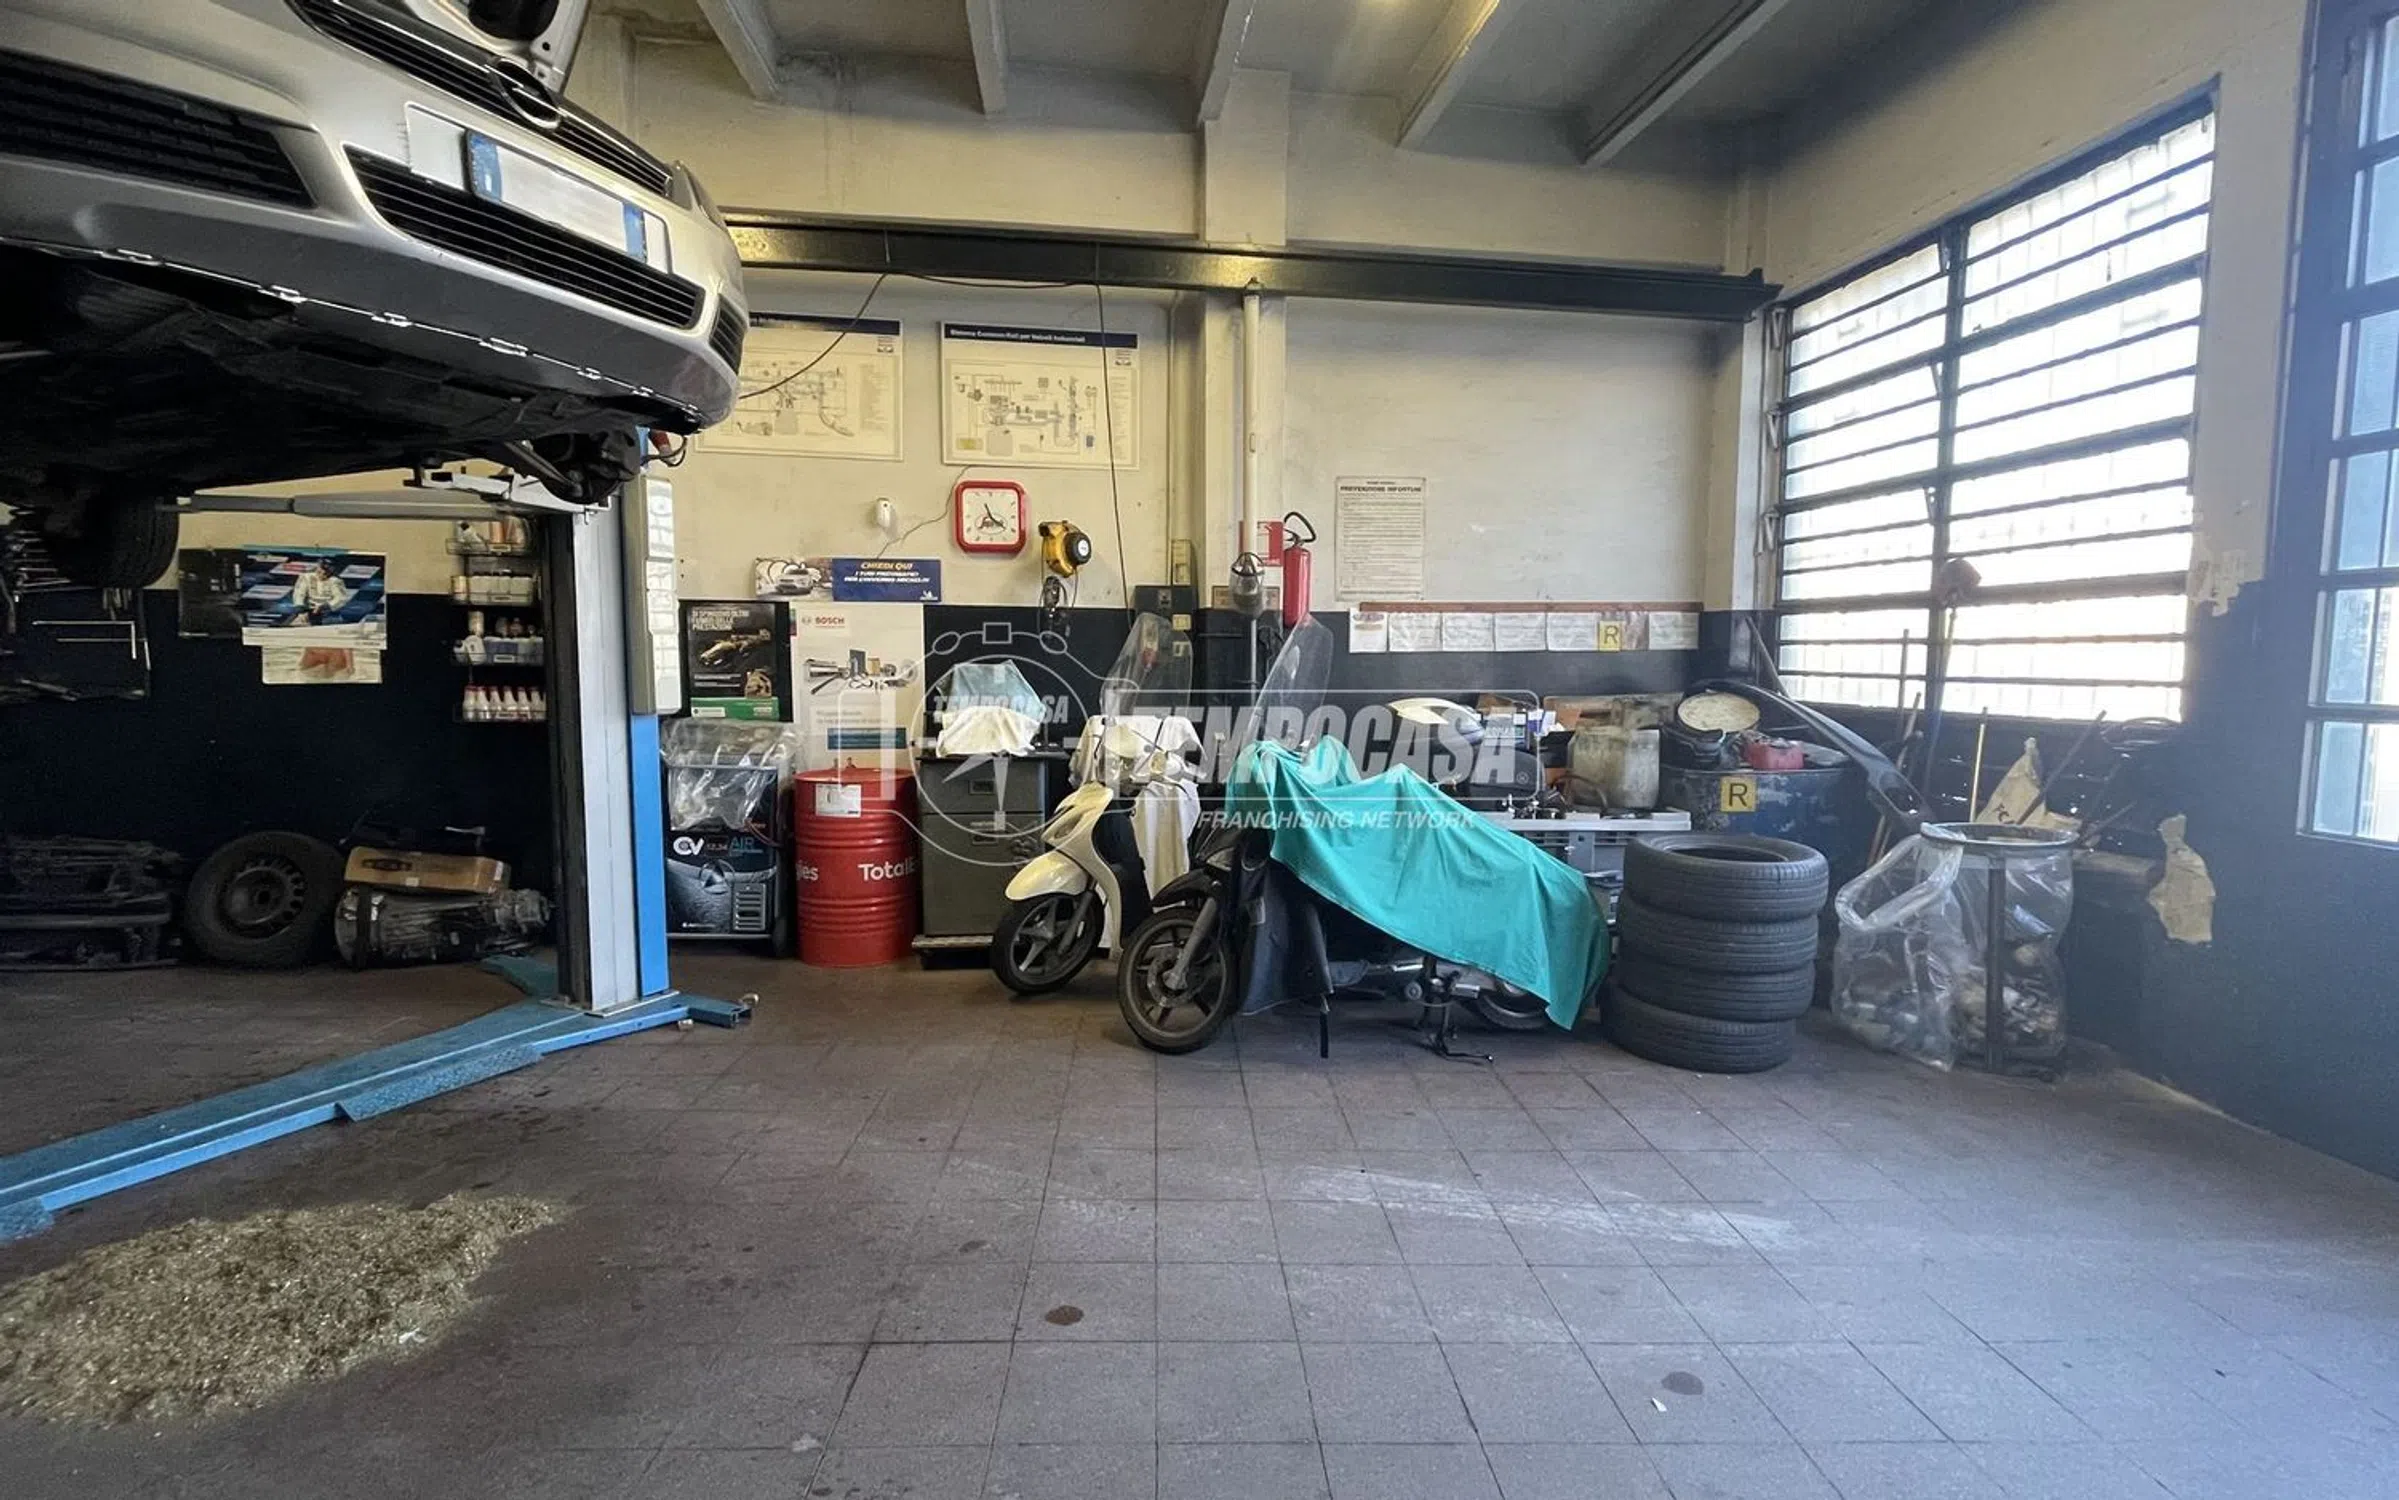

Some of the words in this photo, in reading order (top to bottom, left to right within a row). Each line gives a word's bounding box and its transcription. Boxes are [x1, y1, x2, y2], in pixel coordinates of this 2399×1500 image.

[815, 616, 845, 625] BOSCH
[1603, 625, 1618, 645] R
[1729, 783, 1747, 807] R
